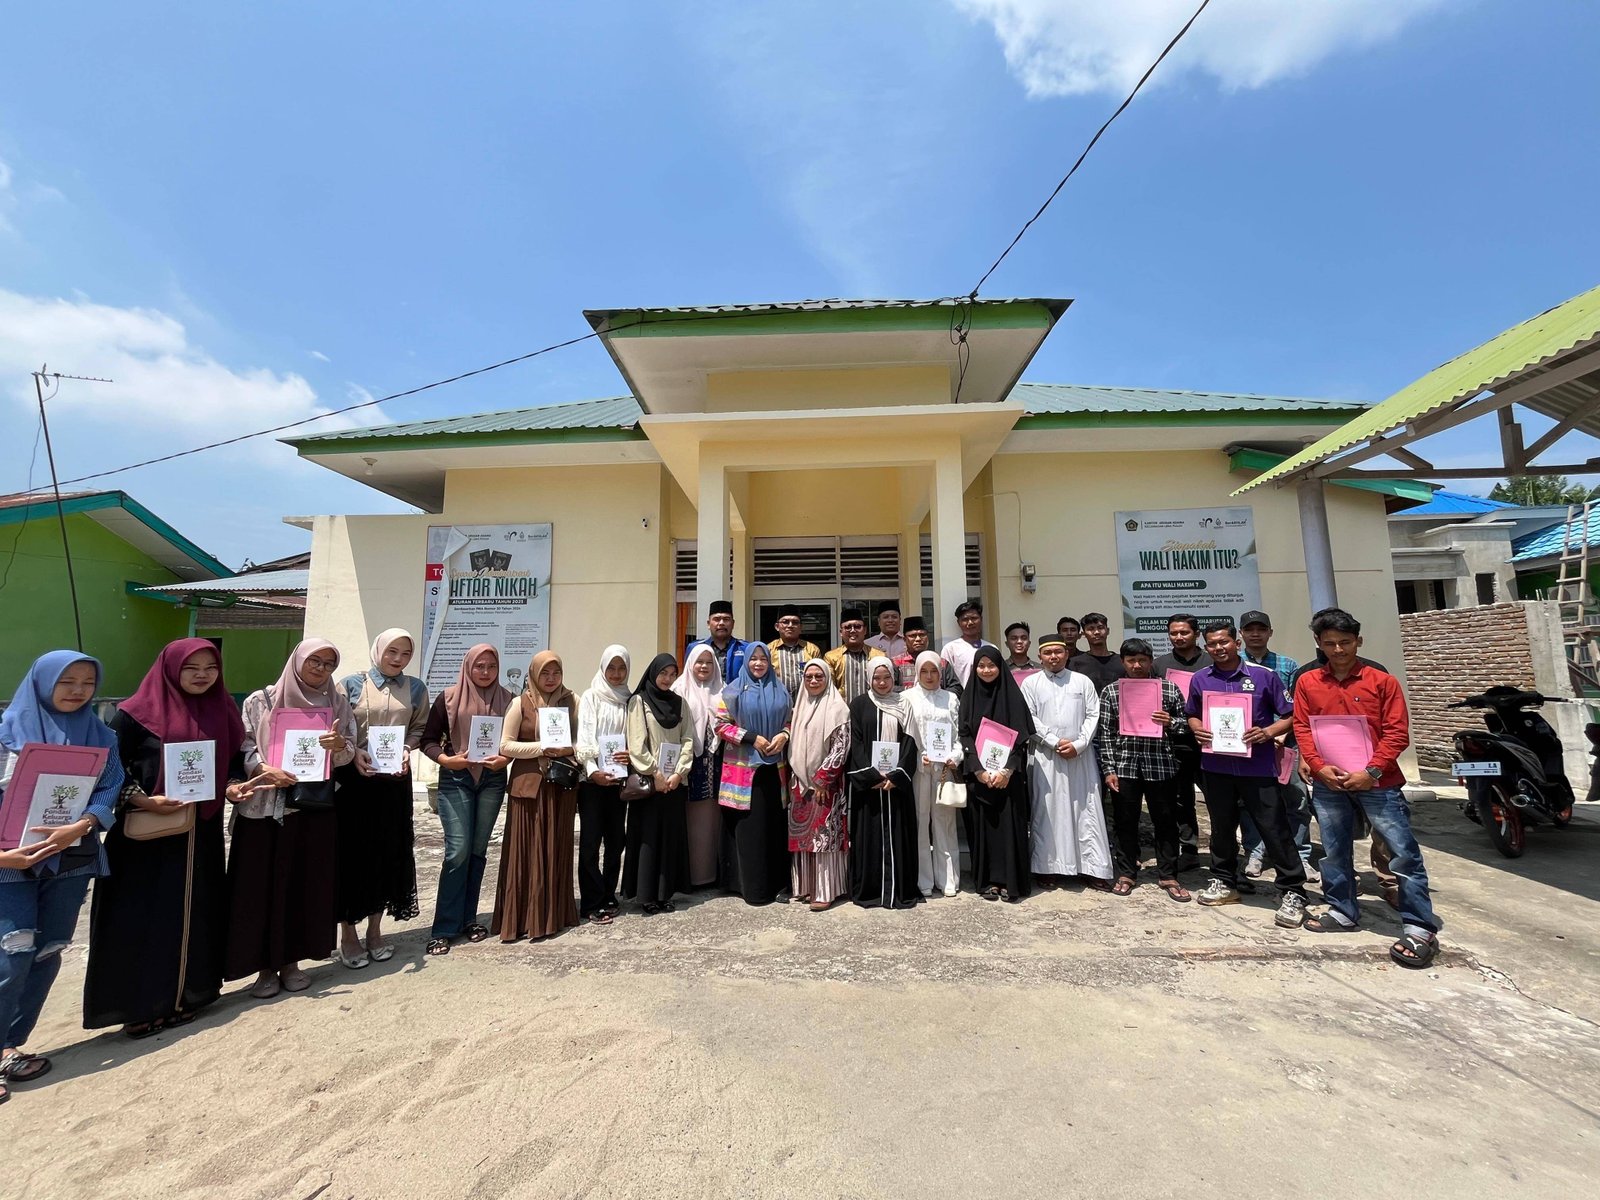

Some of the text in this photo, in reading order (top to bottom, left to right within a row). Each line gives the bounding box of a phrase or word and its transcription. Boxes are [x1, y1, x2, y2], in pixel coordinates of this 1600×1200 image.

[1139, 548, 1238, 571] WALI HAKIM ITU?
[450, 577, 537, 597] AFTAR NIKAH
[177, 773, 206, 781] Keluarga
